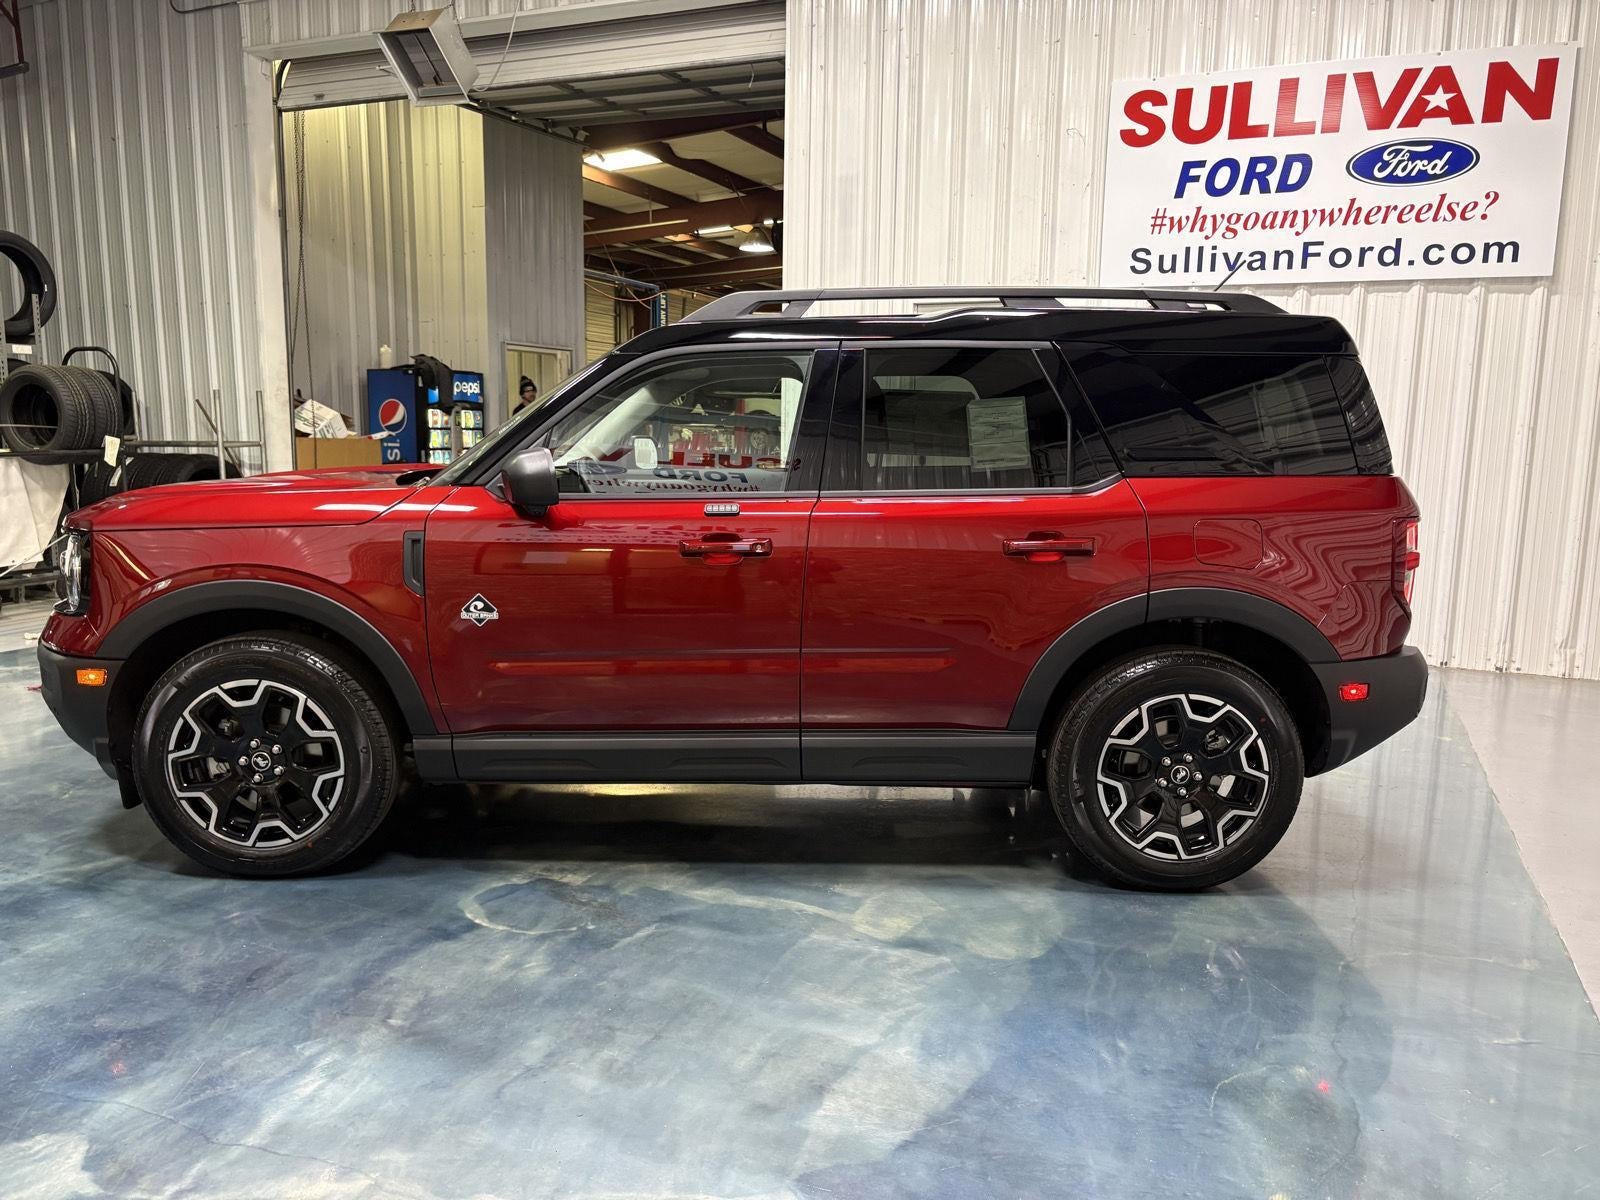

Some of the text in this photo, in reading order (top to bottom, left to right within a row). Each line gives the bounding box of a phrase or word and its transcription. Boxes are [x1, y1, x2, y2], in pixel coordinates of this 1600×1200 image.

[1119, 57, 1560, 148] SULLIVAN
[1173, 153, 1314, 199] FORD
[1373, 145, 1453, 179] Ford
[1150, 190, 1500, 241] #whygoanywhereelse?
[1129, 237, 1521, 275] SullivanFord.com
[453, 380, 481, 396] pepsi
